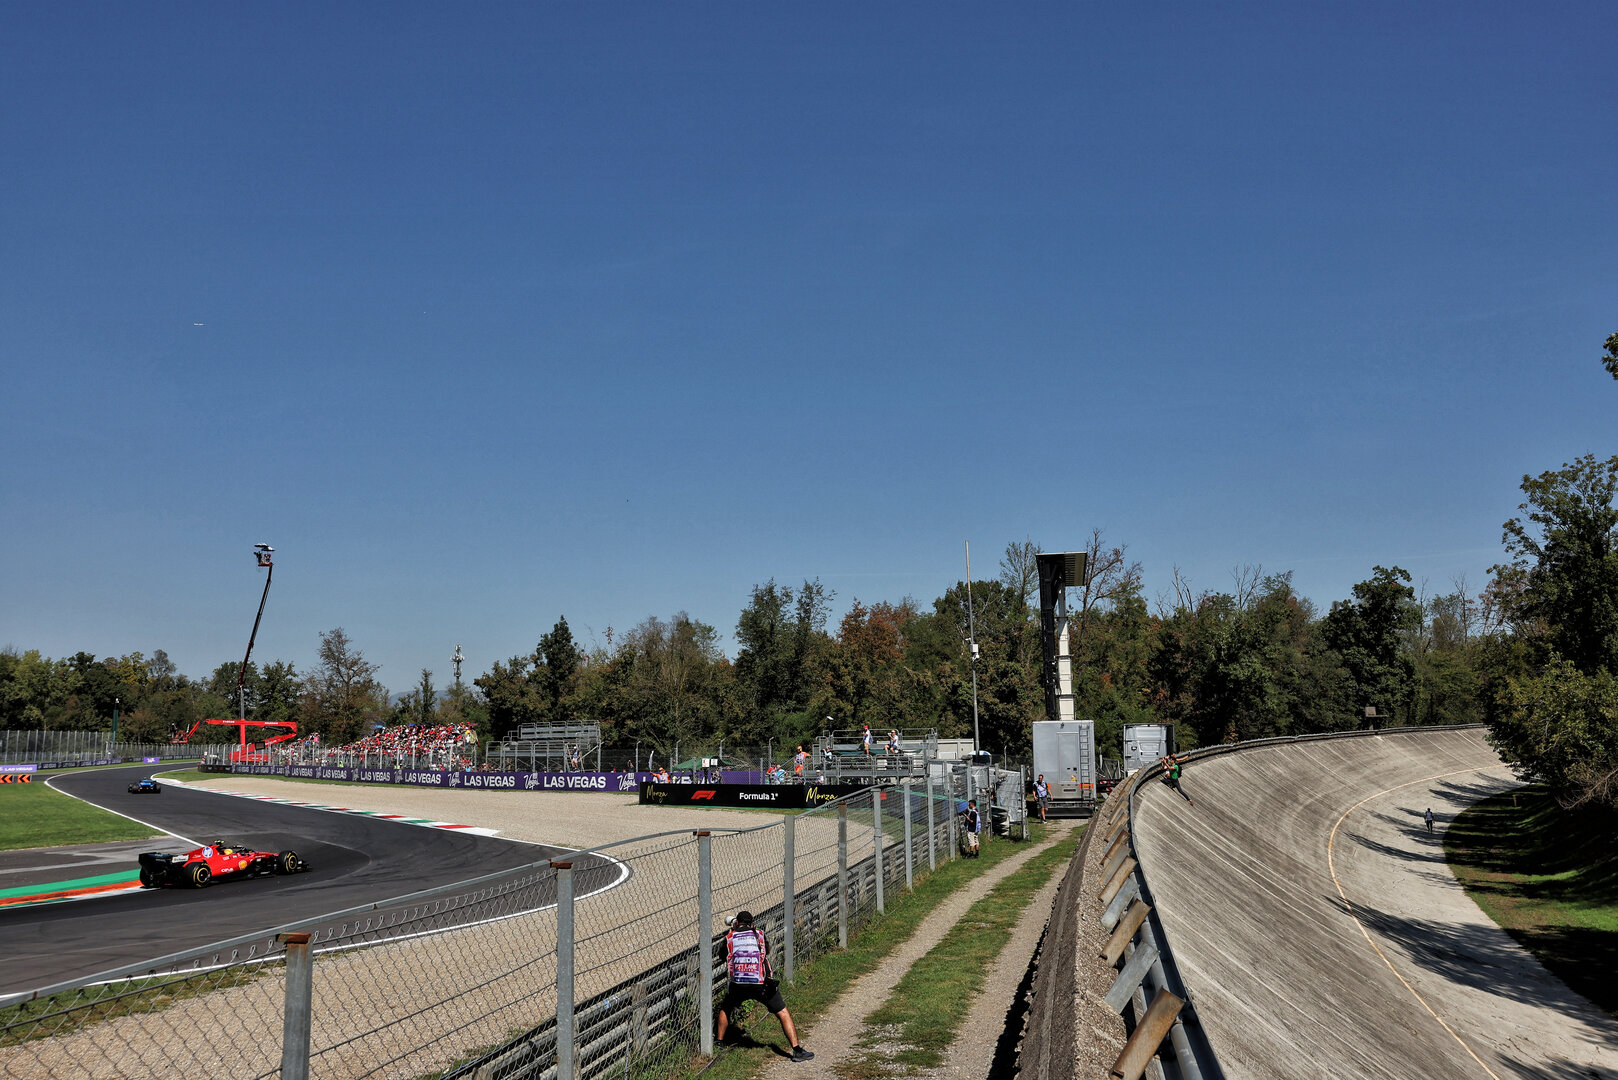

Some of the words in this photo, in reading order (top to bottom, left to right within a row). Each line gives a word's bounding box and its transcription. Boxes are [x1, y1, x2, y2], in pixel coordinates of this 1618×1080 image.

[322, 769, 331, 778] LAS
[331, 770, 347, 779] VEGAS
[360, 771, 371, 780] LAS
[372, 772, 391, 781] VEGAS
[405, 772, 416, 783] LAS
[417, 773, 441, 784] VEGAS
[464, 775, 482, 786] LAS
[483, 775, 515, 787] VEGAS
[544, 776, 565, 788] LAS
[567, 776, 607, 788] VEGAS
[739, 792, 770, 800] Formula
[805, 786, 838, 805] Monza
[733, 956, 759, 964] MEDIA
